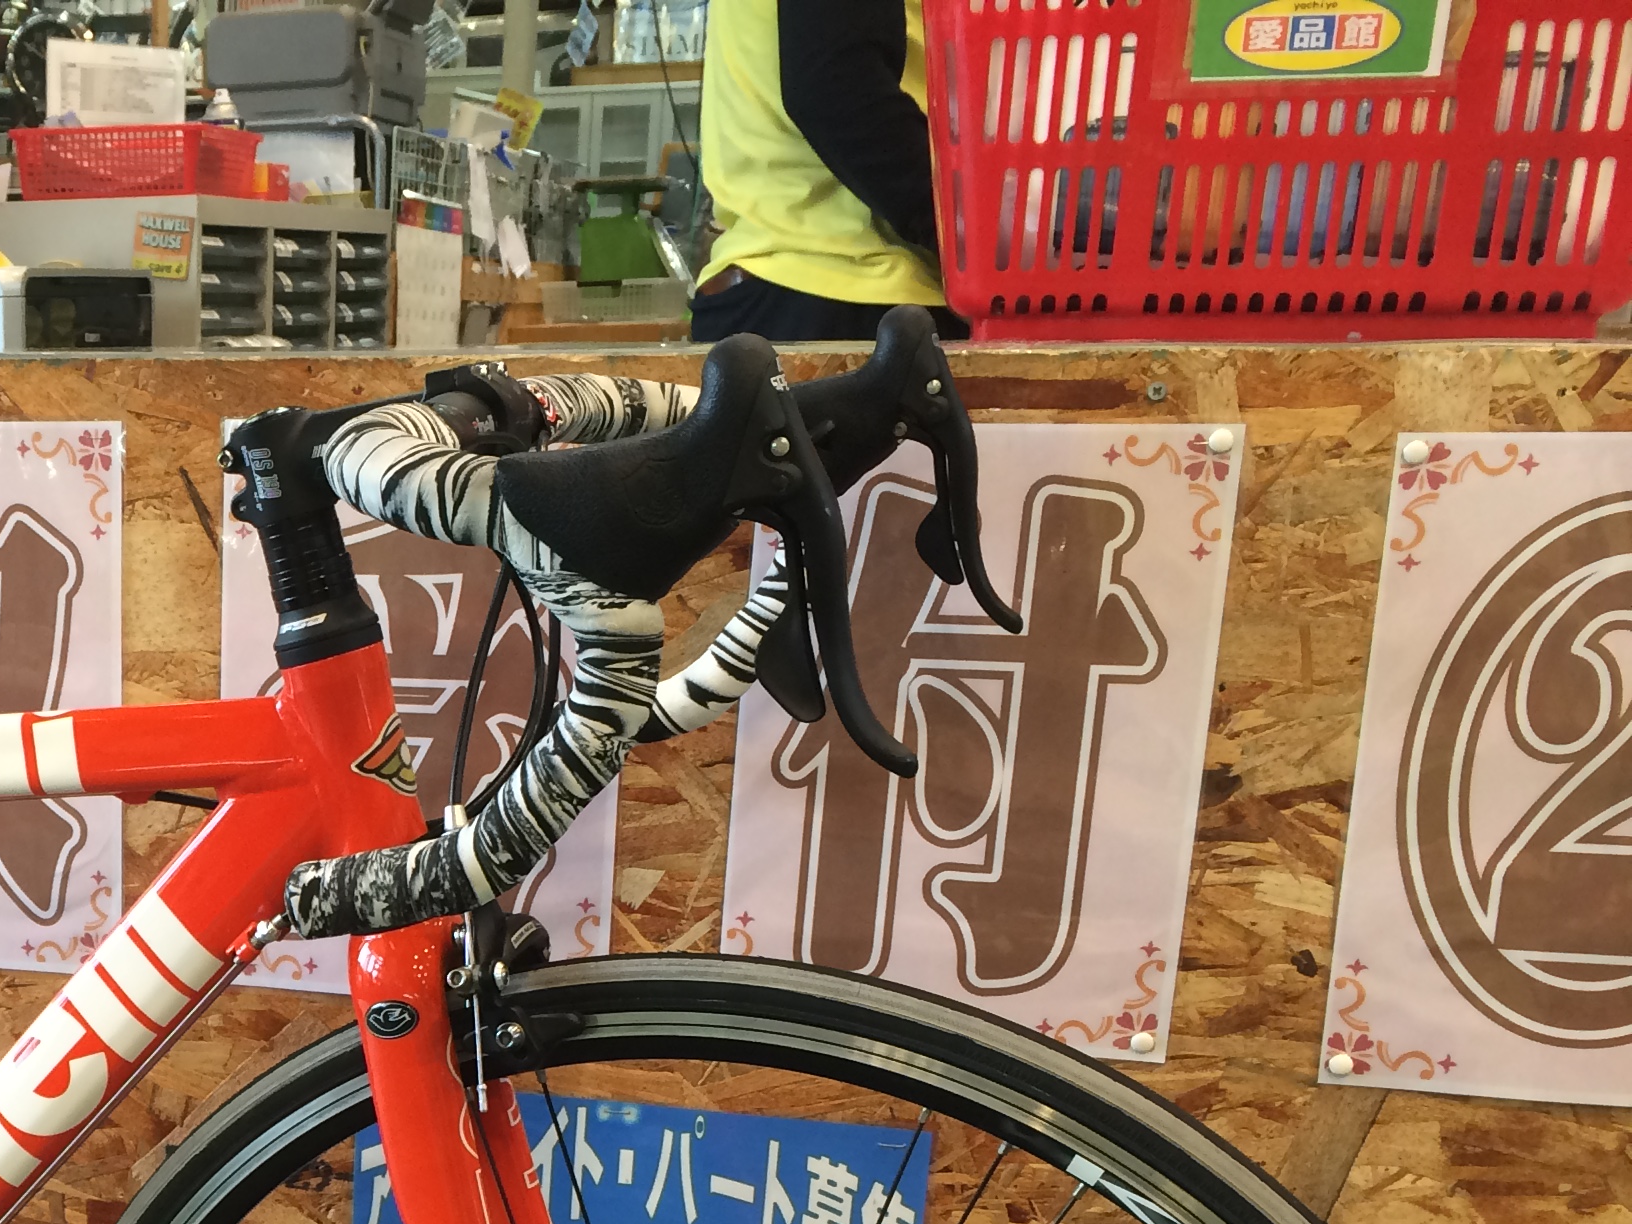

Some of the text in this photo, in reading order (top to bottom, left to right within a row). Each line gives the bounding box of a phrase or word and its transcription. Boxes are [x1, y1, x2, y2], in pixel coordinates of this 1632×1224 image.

[1248, 16, 1380, 50] 愛品館
[143, 233, 181, 250] HOUSE
